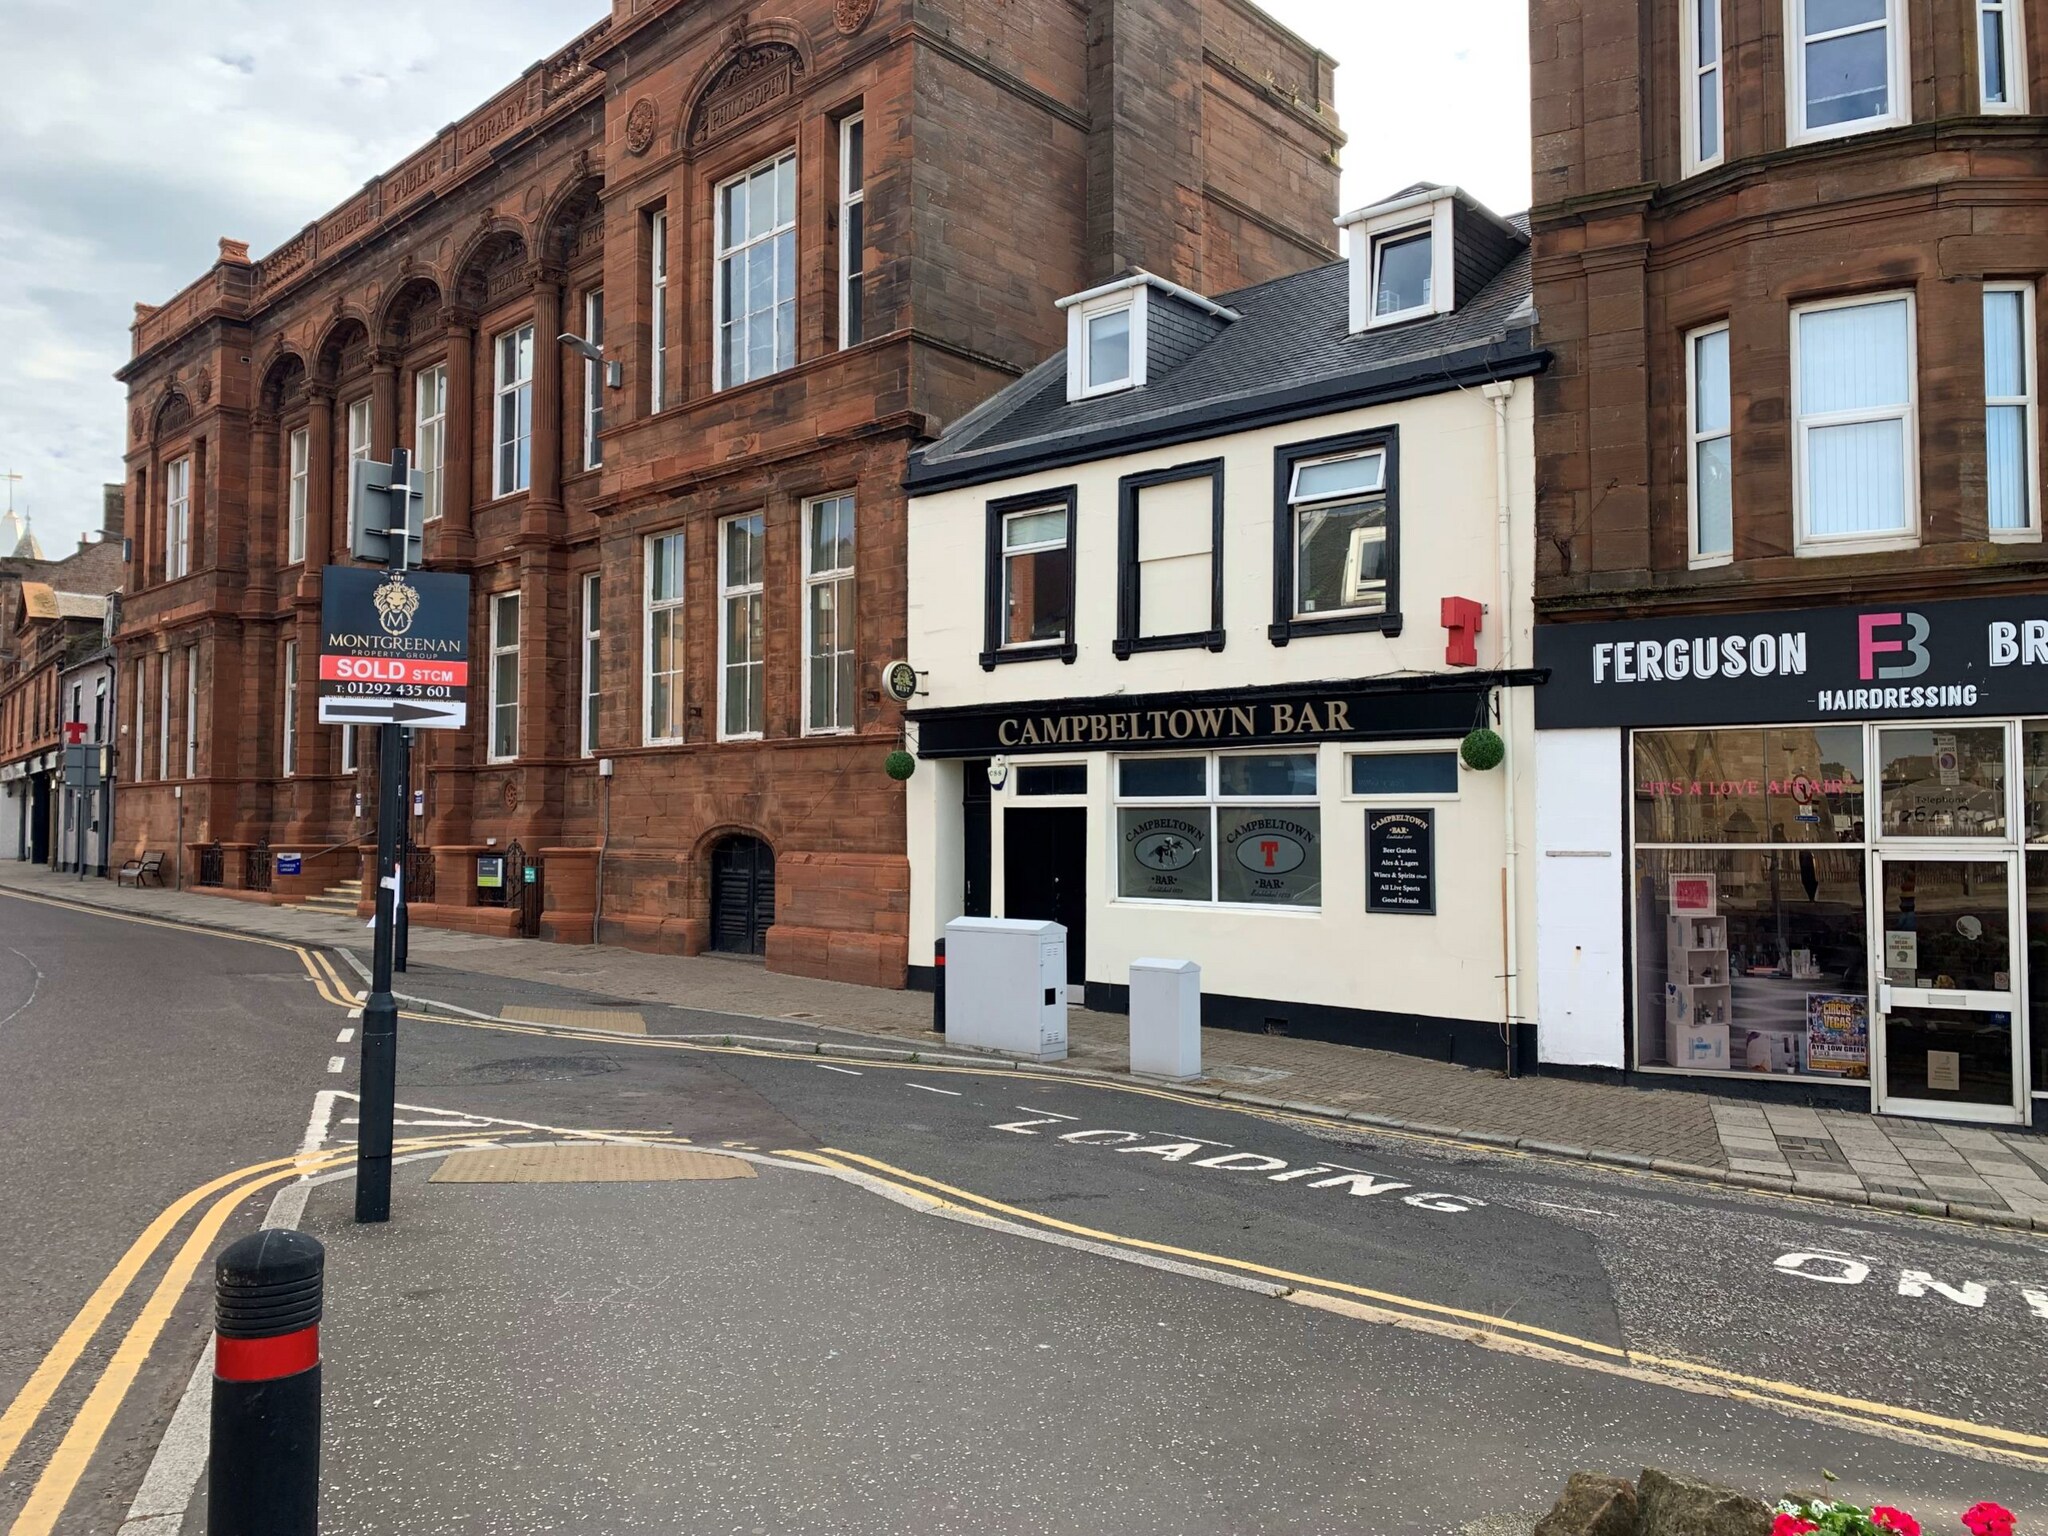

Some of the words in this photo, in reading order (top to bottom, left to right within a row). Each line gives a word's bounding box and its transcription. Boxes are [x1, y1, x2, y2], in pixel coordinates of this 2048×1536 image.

[711, 71, 787, 131] PHILOSOPHY
[321, 204, 369, 249] CARNEGIE
[393, 158, 436, 203] PUBLIC
[387, 611, 405, 628] M
[328, 633, 461, 653] MONTGREENAN
[351, 649, 401, 658] PROPERTY
[406, 652, 439, 660] GROUP
[1592, 632, 1807, 684] FERGUSON
[336, 658, 406, 680] SOLD
[412, 669, 453, 682] STCM
[335, 684, 345, 694] T:
[347, 681, 392, 695] 01292
[396, 685, 422, 697] 435
[426, 686, 452, 698] 601
[895, 684, 911, 693] BEST
[1818, 684, 1978, 711] HAIRDRESSING
[999, 704, 1258, 747] CAMPBELTOWN
[1270, 700, 1356, 735] BAR
[1690, 781, 1702, 795] A
[1709, 779, 1759, 796] LOVE
[1915, 795, 1967, 805] Telephone
[1125, 818, 1205, 842] CAMPBELTOWN
[1226, 818, 1315, 844] CAMPBELTOWN
[1370, 814, 1429, 831] CAMPBELTOWN
[1260, 841, 1279, 867] T
[1398, 872, 1416, 880] Spirits
[1402, 884, 1421, 892] Sports
[1823, 1003, 1851, 1015] CIRCUS
[1823, 1015, 1852, 1030] VEGAS
[988, 1117, 1489, 1213] LOADING
